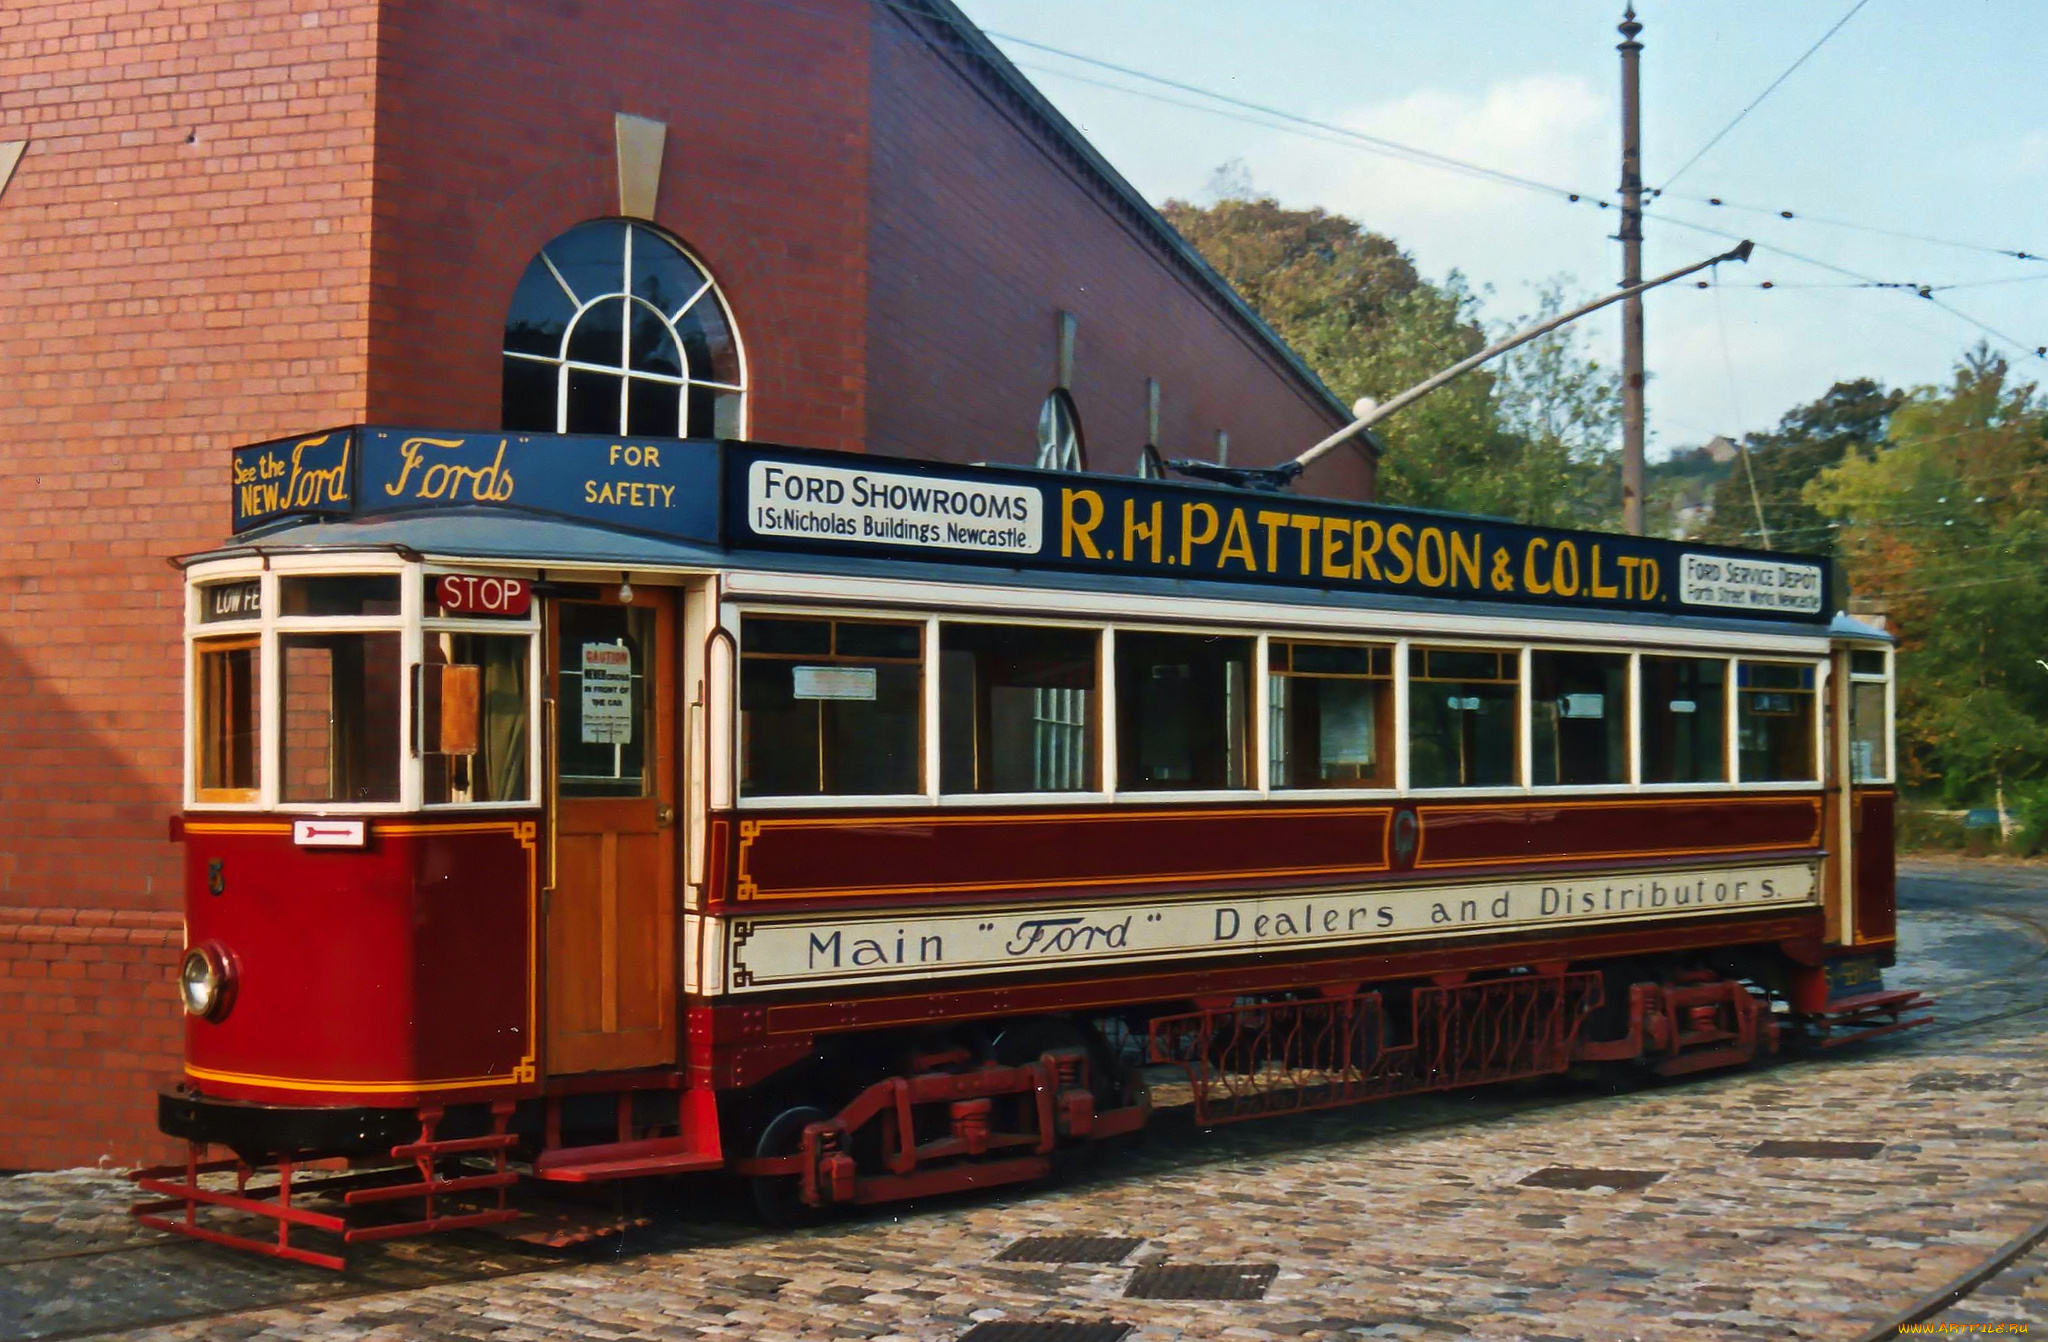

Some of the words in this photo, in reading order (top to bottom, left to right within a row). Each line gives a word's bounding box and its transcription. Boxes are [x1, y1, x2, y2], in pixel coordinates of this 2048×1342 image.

[234, 458, 256, 484] See
[259, 451, 285, 479] the
[610, 445, 661, 468] FOR
[241, 482, 279, 518] NEW
[1490, 546, 1514, 592] &
[216, 588, 240, 614] LOW
[443, 574, 521, 610] STOP
[585, 650, 628, 665] CAUTION
[809, 929, 943, 969] Main
[1213, 904, 1394, 942] Dealers
[1430, 891, 1510, 924] and
